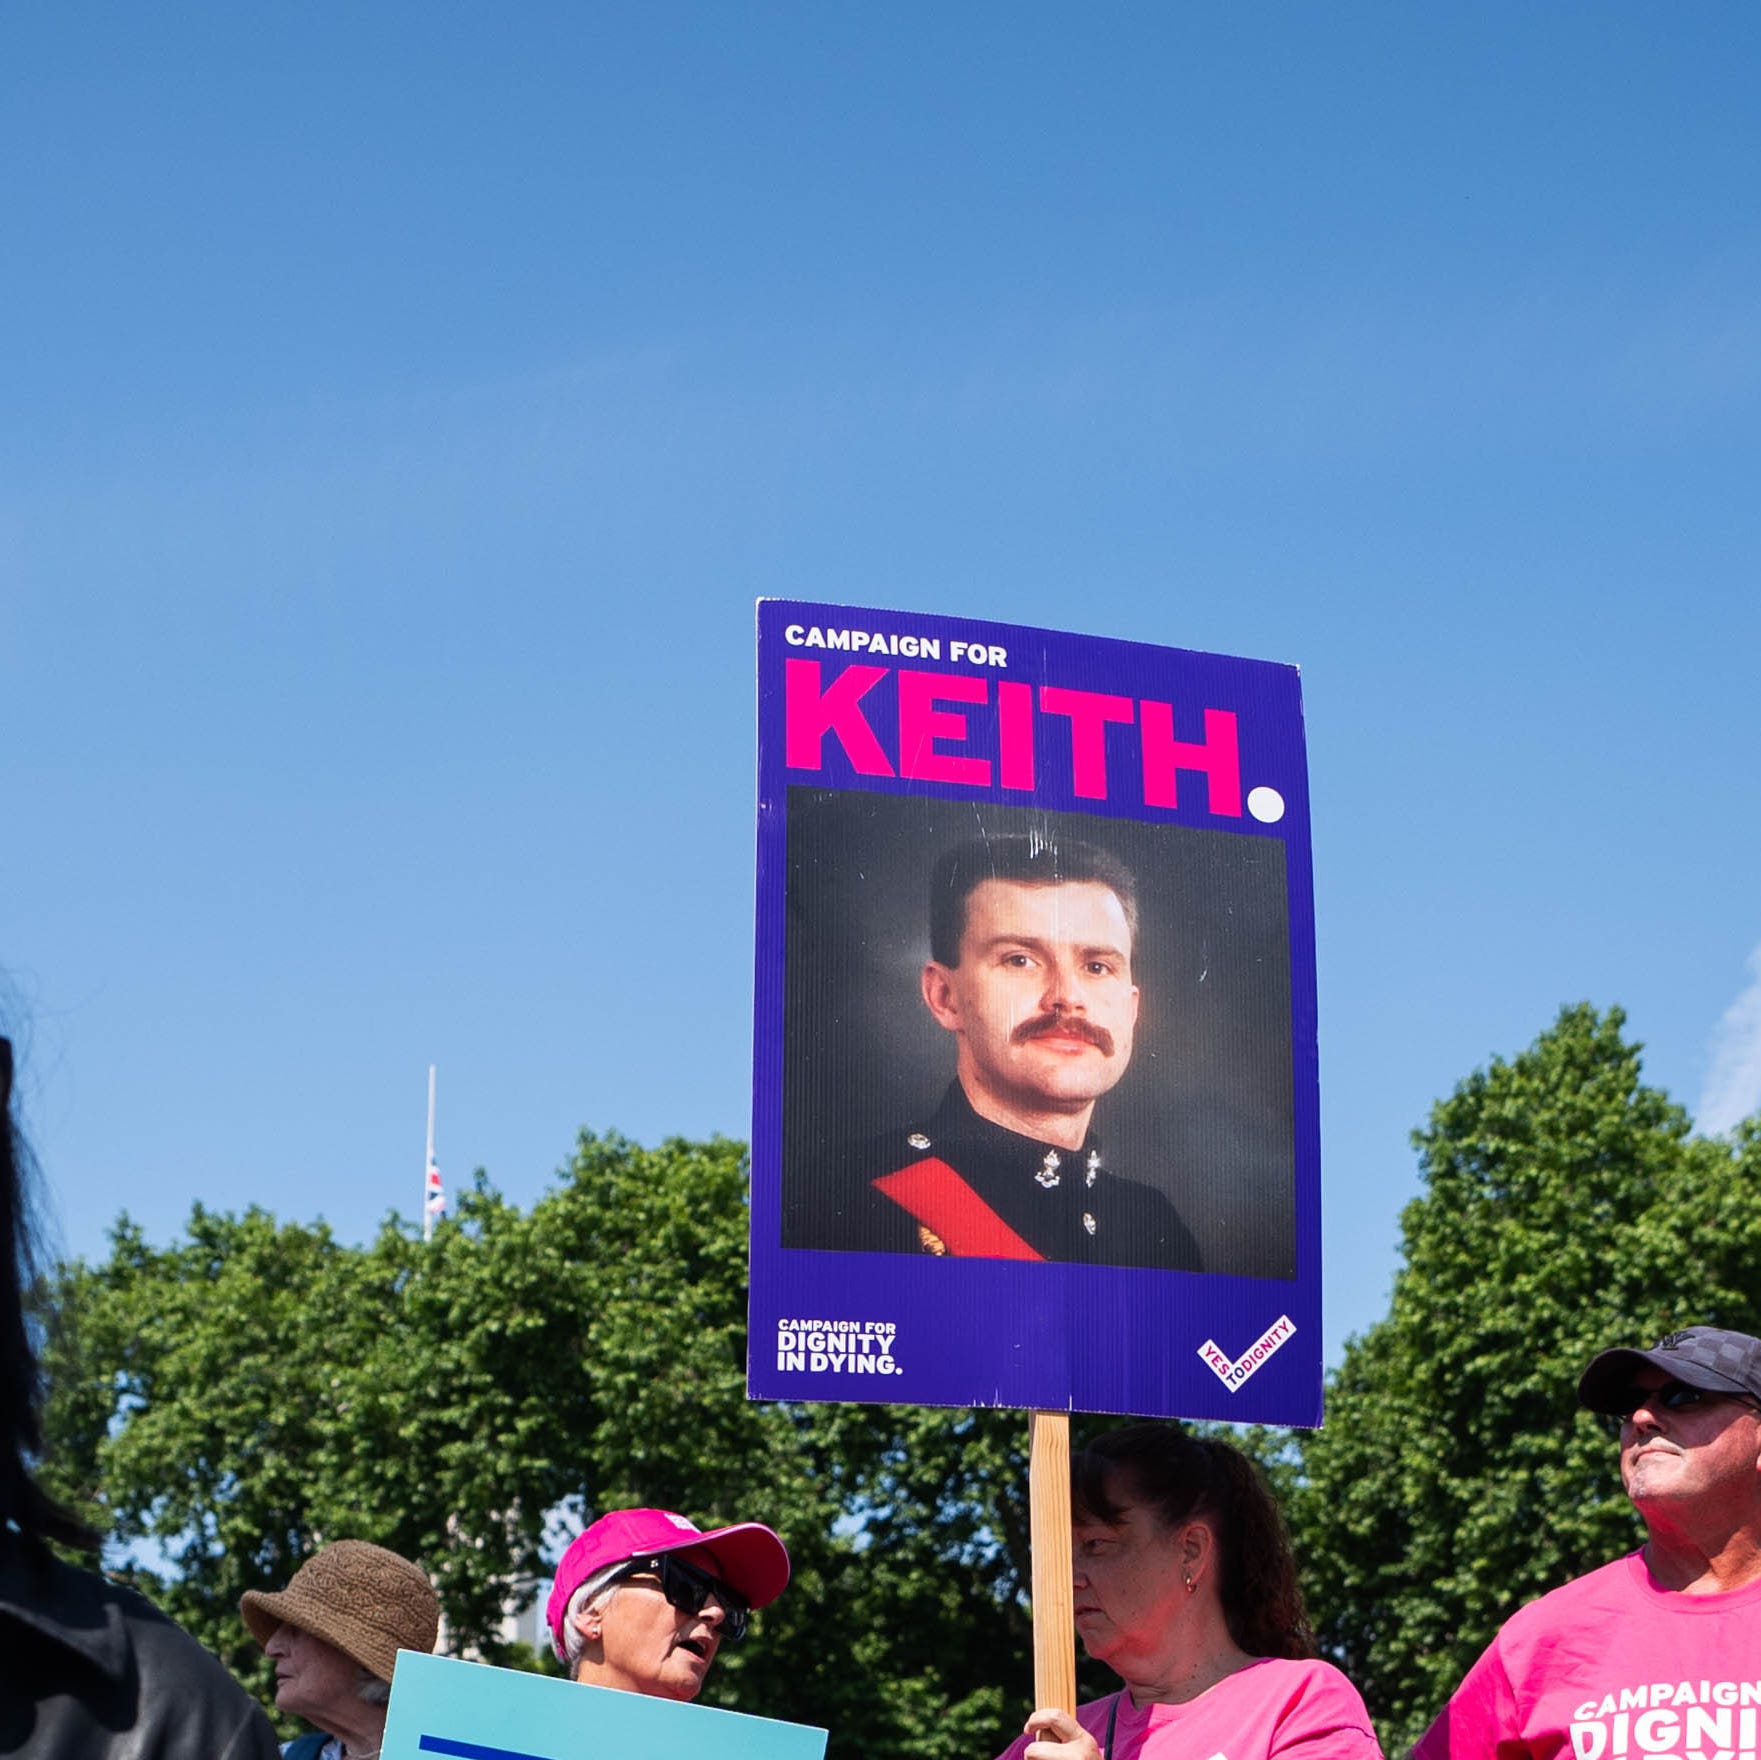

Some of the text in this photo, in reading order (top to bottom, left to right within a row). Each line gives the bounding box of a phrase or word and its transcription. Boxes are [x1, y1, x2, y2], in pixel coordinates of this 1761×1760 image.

[784, 624, 1008, 667] CAMPAIGN FOR
[785, 658, 1285, 823] KEITH.
[778, 1319, 896, 1334] CAMPAIGN FOR
[777, 1331, 896, 1354] DIGNITY
[777, 1352, 903, 1375] IN DYING.
[1205, 1345, 1230, 1375] YES
